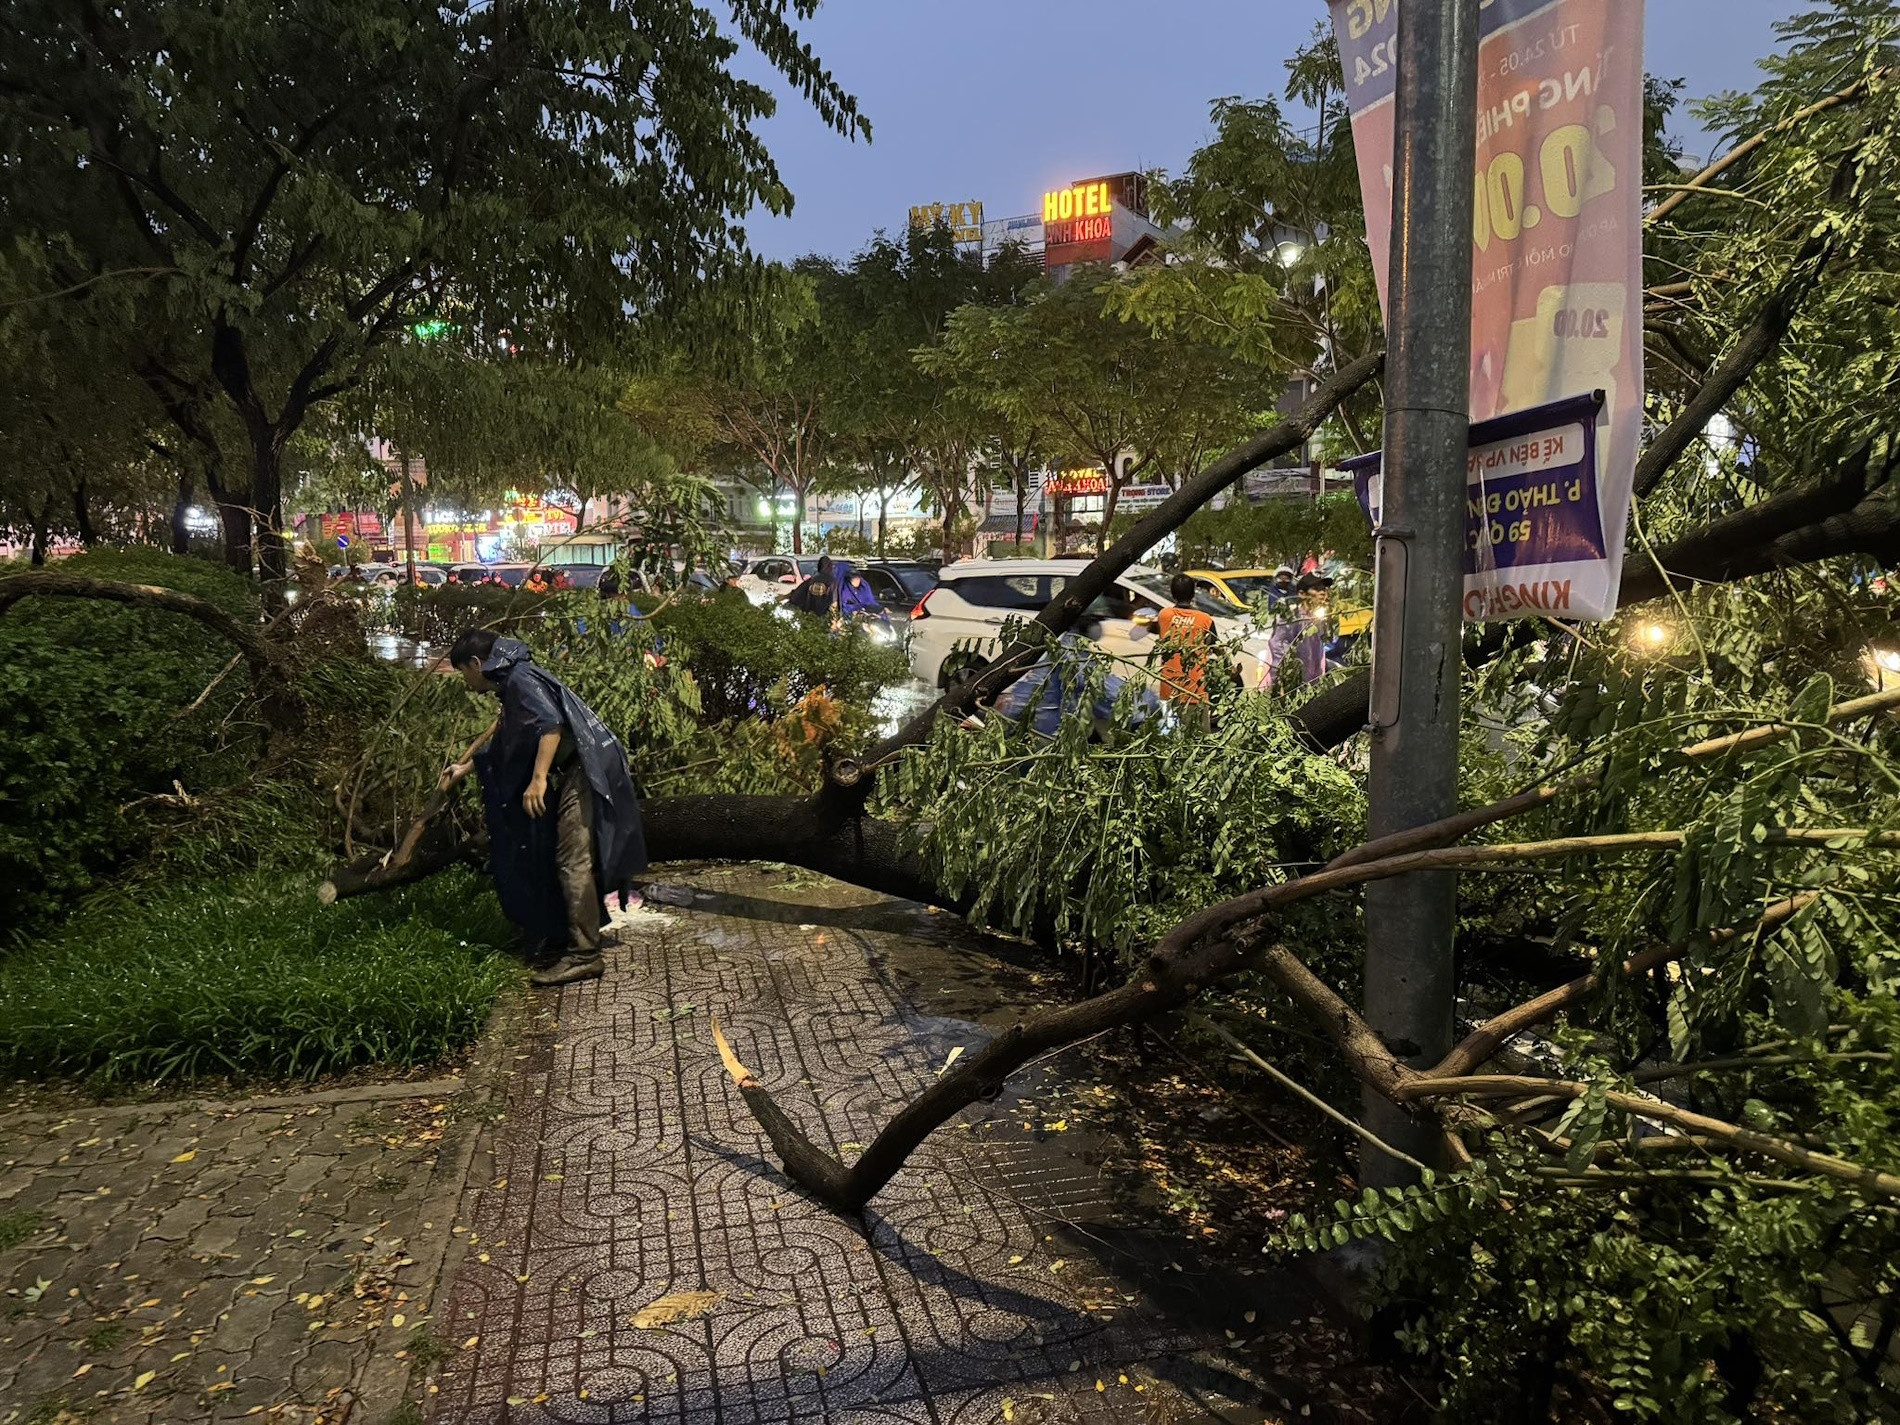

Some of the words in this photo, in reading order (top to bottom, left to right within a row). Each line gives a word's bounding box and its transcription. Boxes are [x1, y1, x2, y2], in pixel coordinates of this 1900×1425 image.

[1044, 182, 1112, 222] HOTEL
[1075, 216, 1112, 241] KHOA
[1486, 450, 1506, 467] VP
[1510, 441, 1540, 466] BÊN
[1505, 483, 1561, 515] THẢO
[1564, 478, 1581, 502] P.
[1508, 520, 1532, 543] 59
[1171, 614, 1196, 626] GHN
